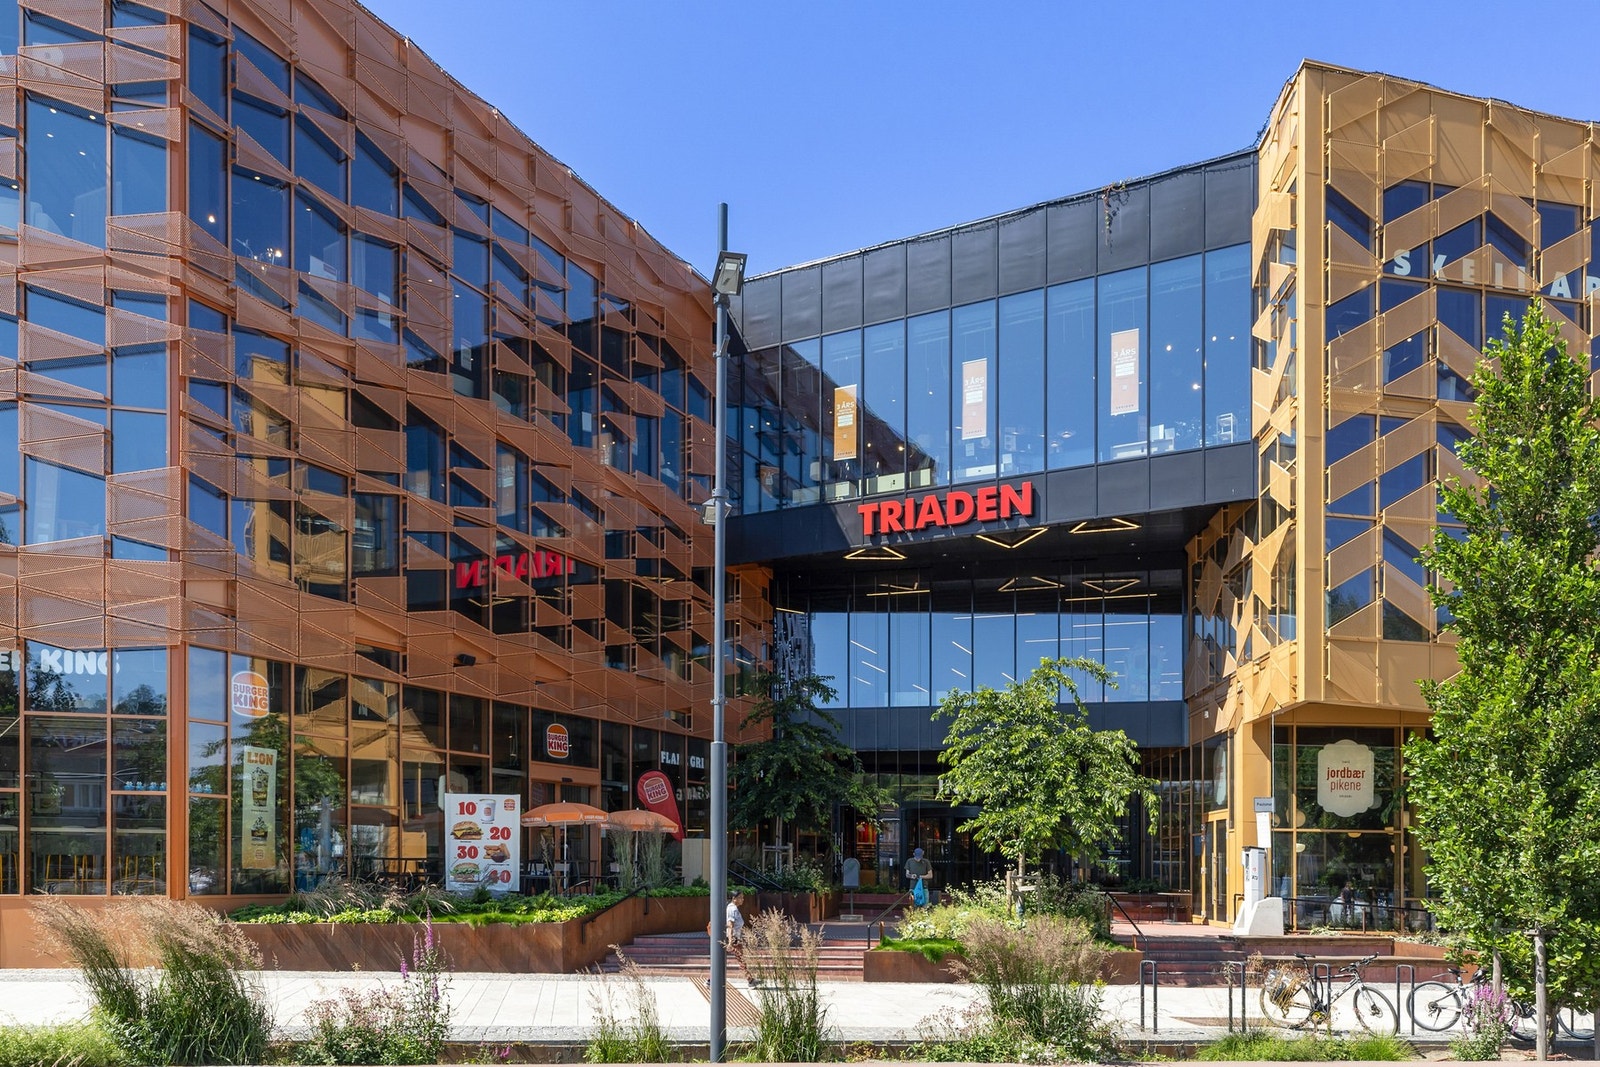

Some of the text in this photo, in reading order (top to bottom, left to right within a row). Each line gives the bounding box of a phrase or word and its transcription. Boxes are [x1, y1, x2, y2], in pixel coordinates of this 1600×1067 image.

[857, 481, 1033, 537] TRIADEN
[41, 649, 120, 675] KING
[233, 684, 268, 698] BURGER
[233, 693, 269, 709] KING
[548, 733, 568, 743] BURGER
[548, 740, 568, 752] KING
[247, 751, 274, 766] LION
[661, 750, 680, 765] FLA
[1326, 766, 1366, 781] jordbær
[1330, 779, 1362, 793] pikene
[647, 788, 667, 800] KING
[458, 801, 477, 816] 10
[489, 826, 511, 841] 20
[457, 845, 479, 860] 30
